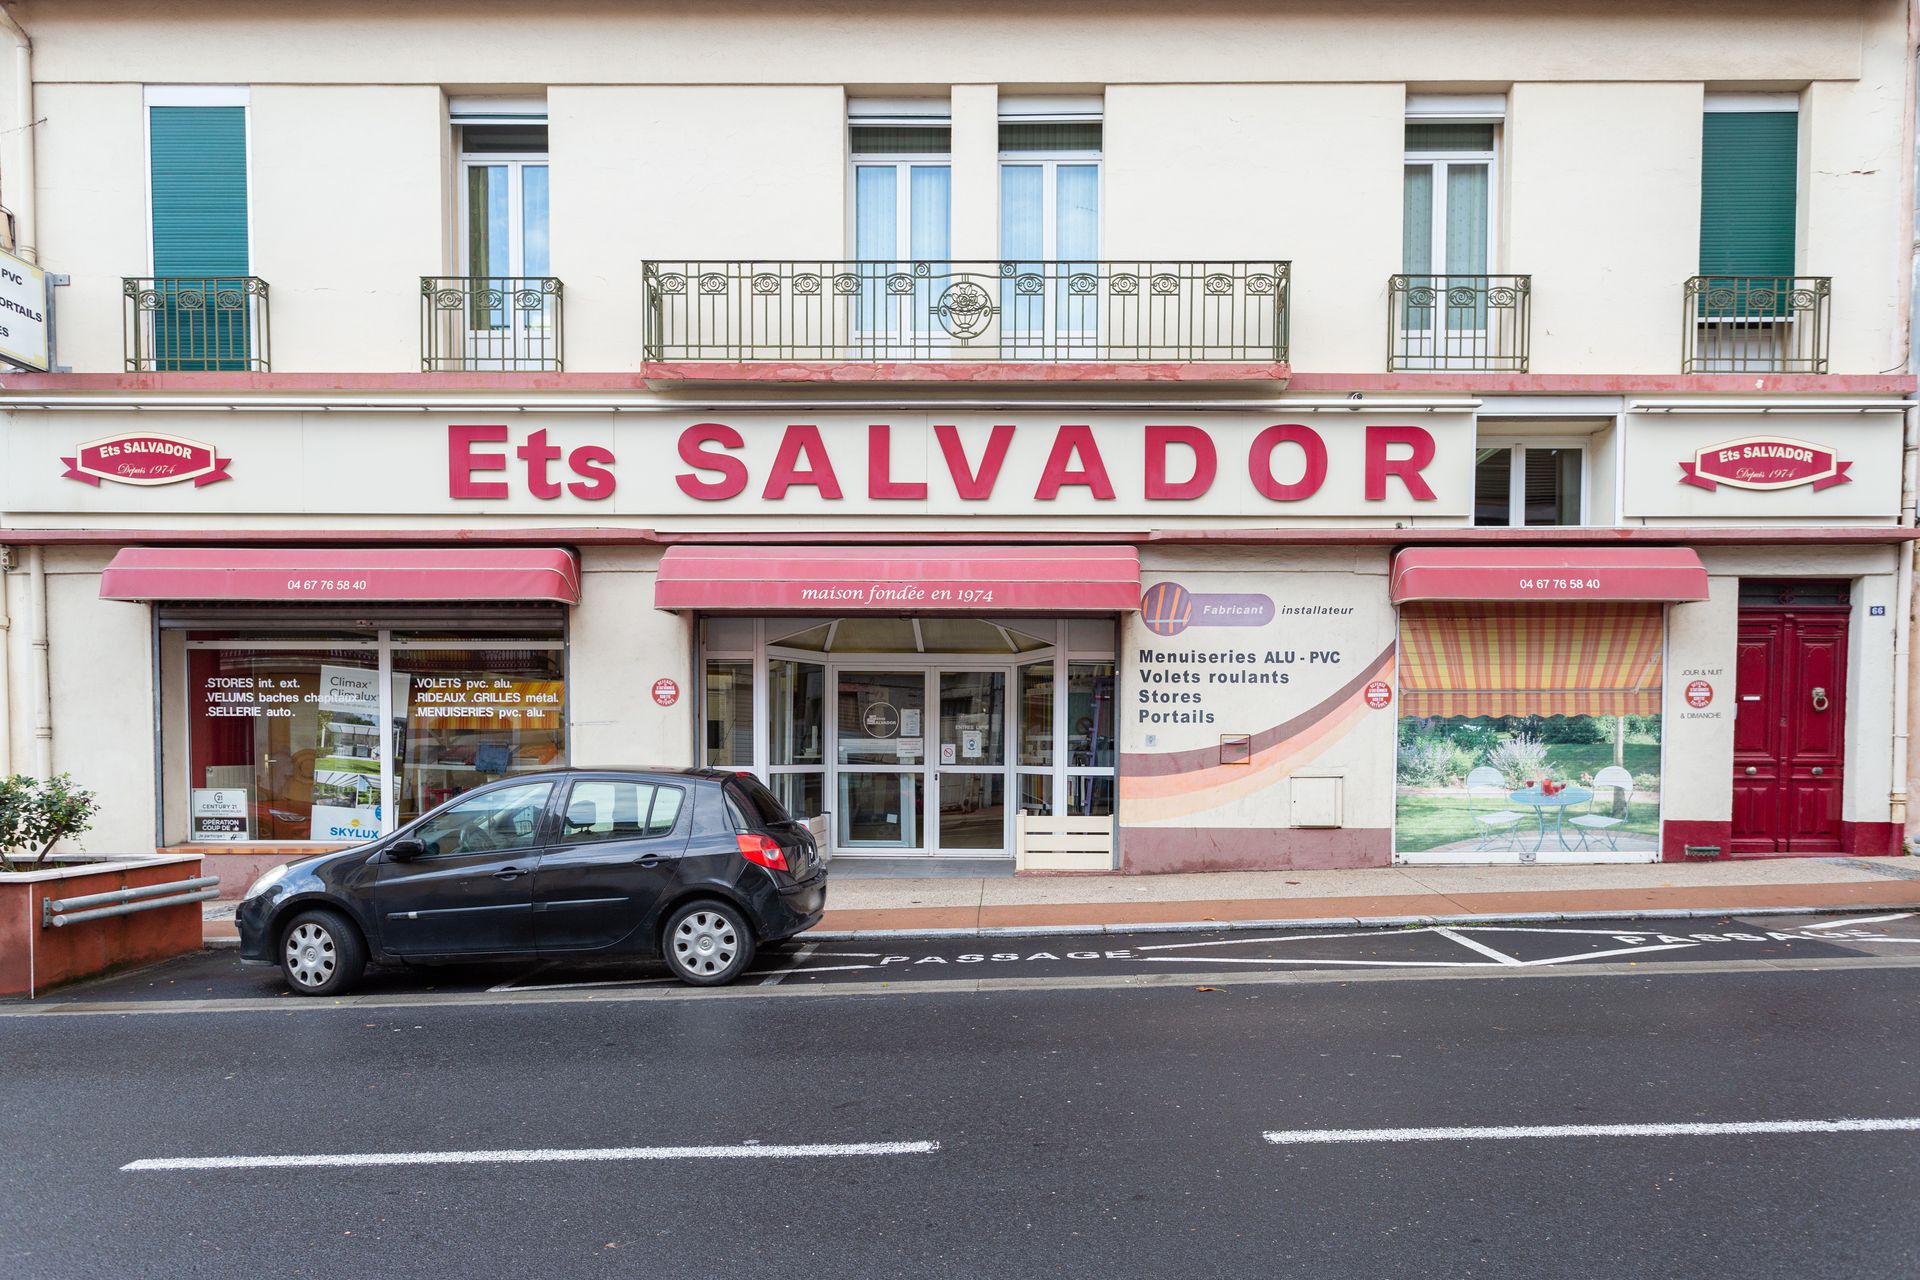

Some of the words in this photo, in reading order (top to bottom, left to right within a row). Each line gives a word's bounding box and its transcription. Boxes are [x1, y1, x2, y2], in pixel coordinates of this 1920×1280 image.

[1, 268, 23, 286] PVC
[100, 445, 121, 459] Ets
[124, 442, 192, 459] SALVADOR
[1719, 450, 1741, 463] Ets
[1743, 446, 1813, 463] SALVADOR
[448, 424, 616, 501] Ets
[674, 422, 1438, 501] SALVADOR
[117, 463, 146, 477] Depuis
[149, 464, 176, 474] 1974
[1735, 467, 1765, 481] Depuis
[1768, 468, 1797, 478] 1974
[287, 580, 301, 590] 04
[304, 580, 318, 590] 67
[321, 580, 334, 590] 76
[336, 580, 350, 590] 58
[352, 580, 366, 590] 40
[1520, 579, 1533, 589] 04
[1536, 579, 1550, 589] 67
[1553, 579, 1567, 589] 76
[1569, 579, 1583, 589] 58
[1586, 579, 1600, 589] 40
[801, 585, 863, 600] maison
[864, 585, 925, 605] fondée
[931, 589, 952, 600] en
[957, 589, 993, 603] 1974
[1203, 605, 1264, 616] Fabricant
[1281, 604, 1354, 615] installateur
[1871, 607, 1884, 615] 66
[1139, 650, 1257, 663] Menuiseries
[1264, 651, 1295, 663] ALU
[1309, 650, 1341, 663] PVC
[205, 677, 254, 688] .STORES
[258, 678, 275, 688] int.
[280, 679, 300, 688] ext.
[1139, 669, 1201, 683] Volets
[1208, 669, 1290, 684] roulants
[414, 678, 461, 689] .VOLETS
[466, 680, 489, 690] pvc.
[493, 678, 513, 689] alu.
[205, 692, 254, 702] .VELUMS
[259, 692, 299, 702] baches
[415, 692, 466, 703] .RIDEAUX
[471, 692, 521, 703] .GRILLES
[525, 692, 559, 703] métal.
[1138, 689, 1202, 703] Stores
[205, 706, 261, 717] .SELLERIE
[415, 707, 494, 717] .MENUISERIES
[498, 708, 521, 719] pvc.
[526, 707, 545, 717] alu.
[1138, 709, 1215, 724] Portails
[202, 818, 239, 826] OPÉRATION
[330, 826, 379, 839] SKYLUX
[1612, 929, 1889, 945] PASSAGE
[880, 949, 1132, 966] PASSAGE
